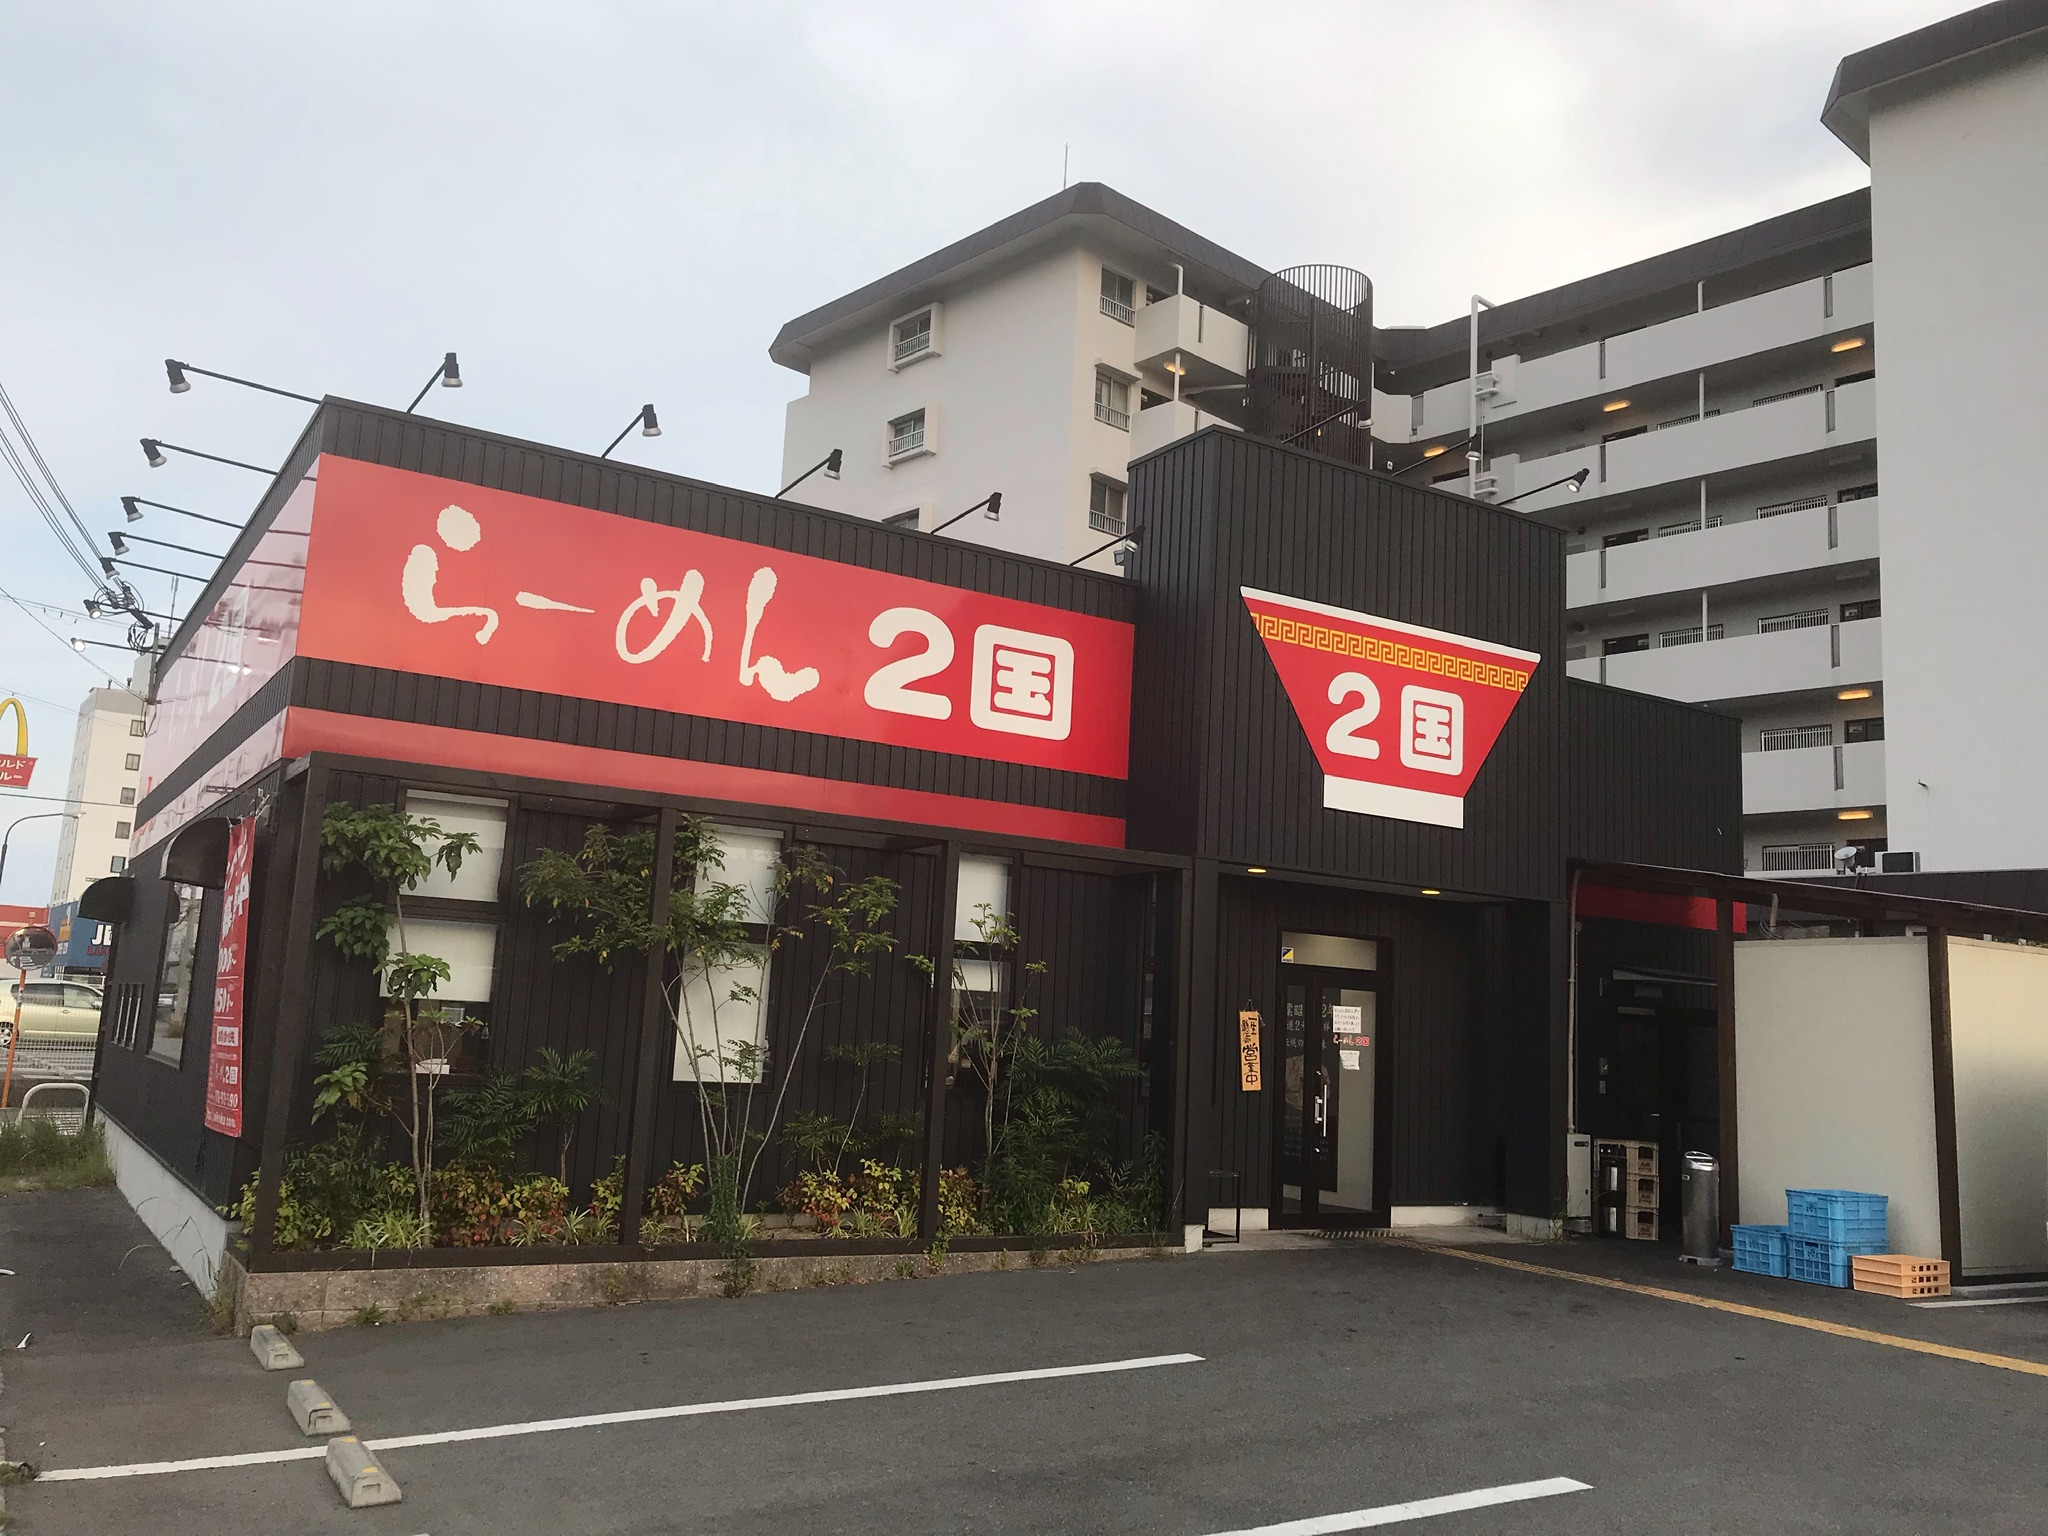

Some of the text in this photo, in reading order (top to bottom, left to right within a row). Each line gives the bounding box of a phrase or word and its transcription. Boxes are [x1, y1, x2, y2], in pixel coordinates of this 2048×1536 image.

[400, 503, 821, 703] らーめん
[863, 605, 1077, 741] 2国
[0, 759, 27, 770] ルド
[1325, 670, 1466, 777] 2国
